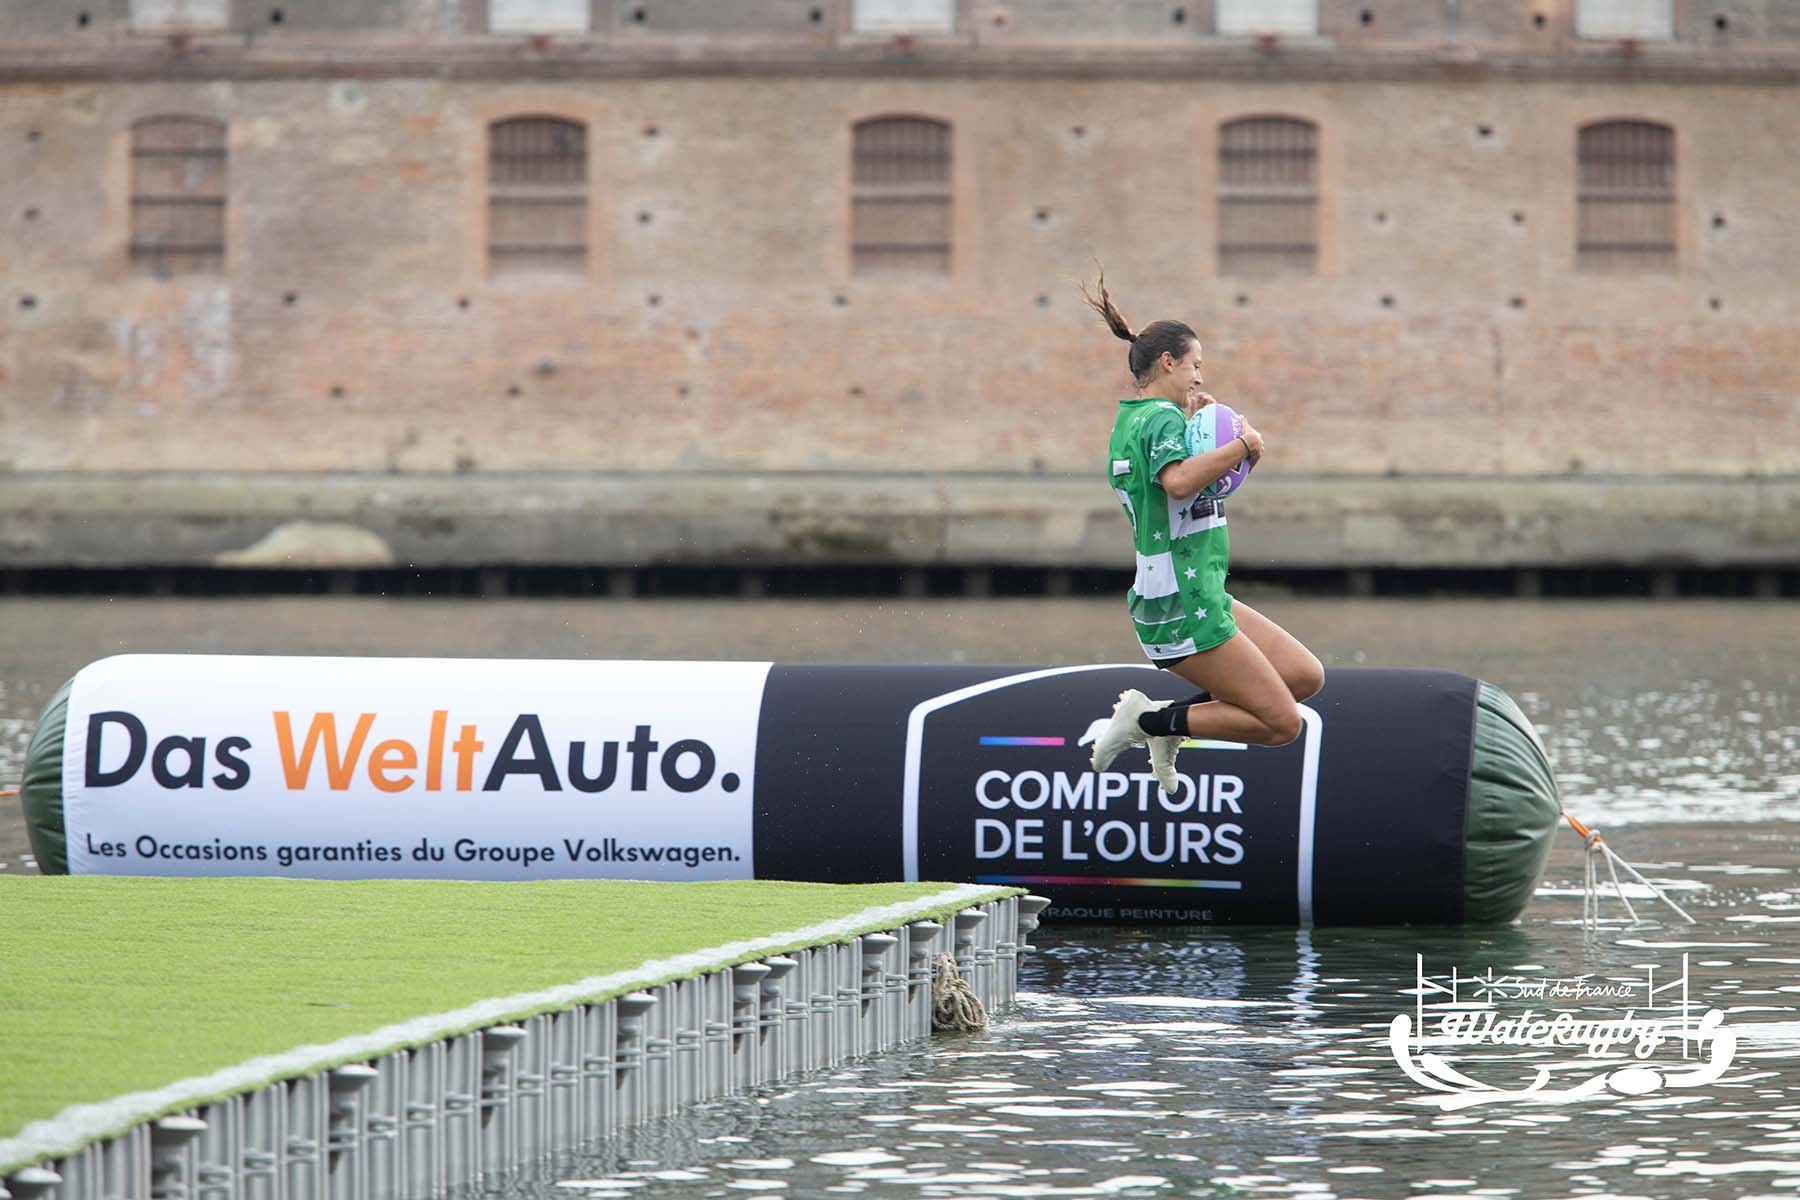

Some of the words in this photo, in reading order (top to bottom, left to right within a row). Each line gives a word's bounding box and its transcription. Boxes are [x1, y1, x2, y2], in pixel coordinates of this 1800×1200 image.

[84, 711, 252, 791] Das
[273, 710, 742, 793] WeltAuto.
[975, 769, 1244, 814] COMPTOIR
[86, 832, 128, 859] Les
[135, 834, 268, 862] Occasions
[276, 838, 403, 868] garanties
[411, 837, 445, 863] du
[454, 838, 556, 868] Groupe
[563, 837, 741, 869] Volkswagen.
[974, 818, 1044, 860] DE
[1061, 819, 1244, 865] L’OURS
[1120, 908, 1213, 921] PEINTURE
